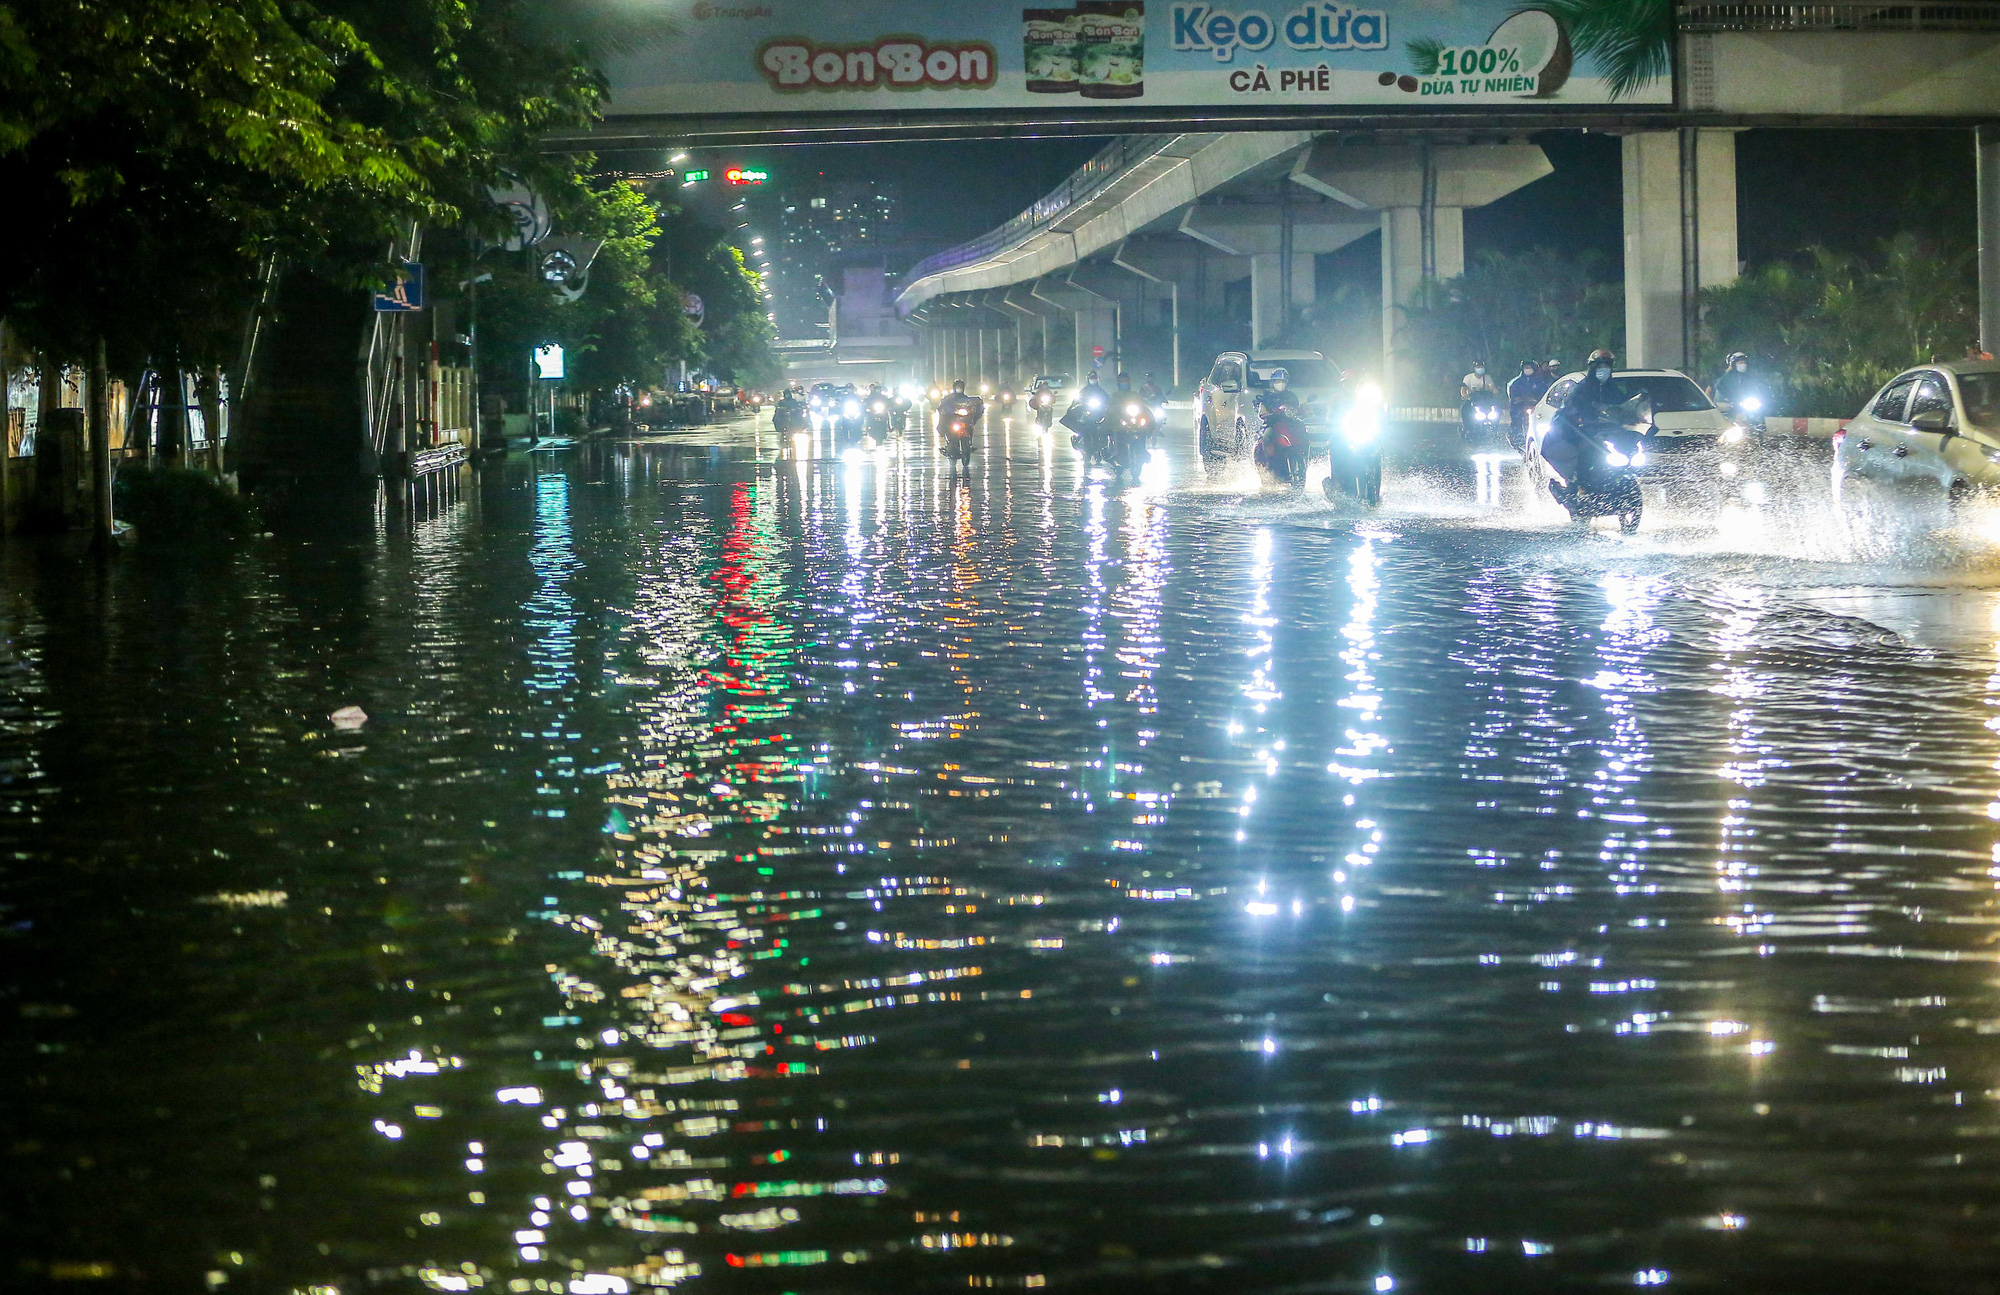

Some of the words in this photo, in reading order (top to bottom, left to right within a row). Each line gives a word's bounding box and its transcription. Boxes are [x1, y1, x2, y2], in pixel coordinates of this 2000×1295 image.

[1174, 7, 1268, 56] Kẹo
[1285, 3, 1381, 45] dừa
[1441, 47, 1519, 76] 100%
[1229, 64, 1271, 92] CÀ
[1280, 64, 1330, 91] PHÊ
[1421, 78, 1454, 95] DỪA
[1460, 79, 1481, 96] TỰ
[1484, 74, 1535, 93] NHIÊN
